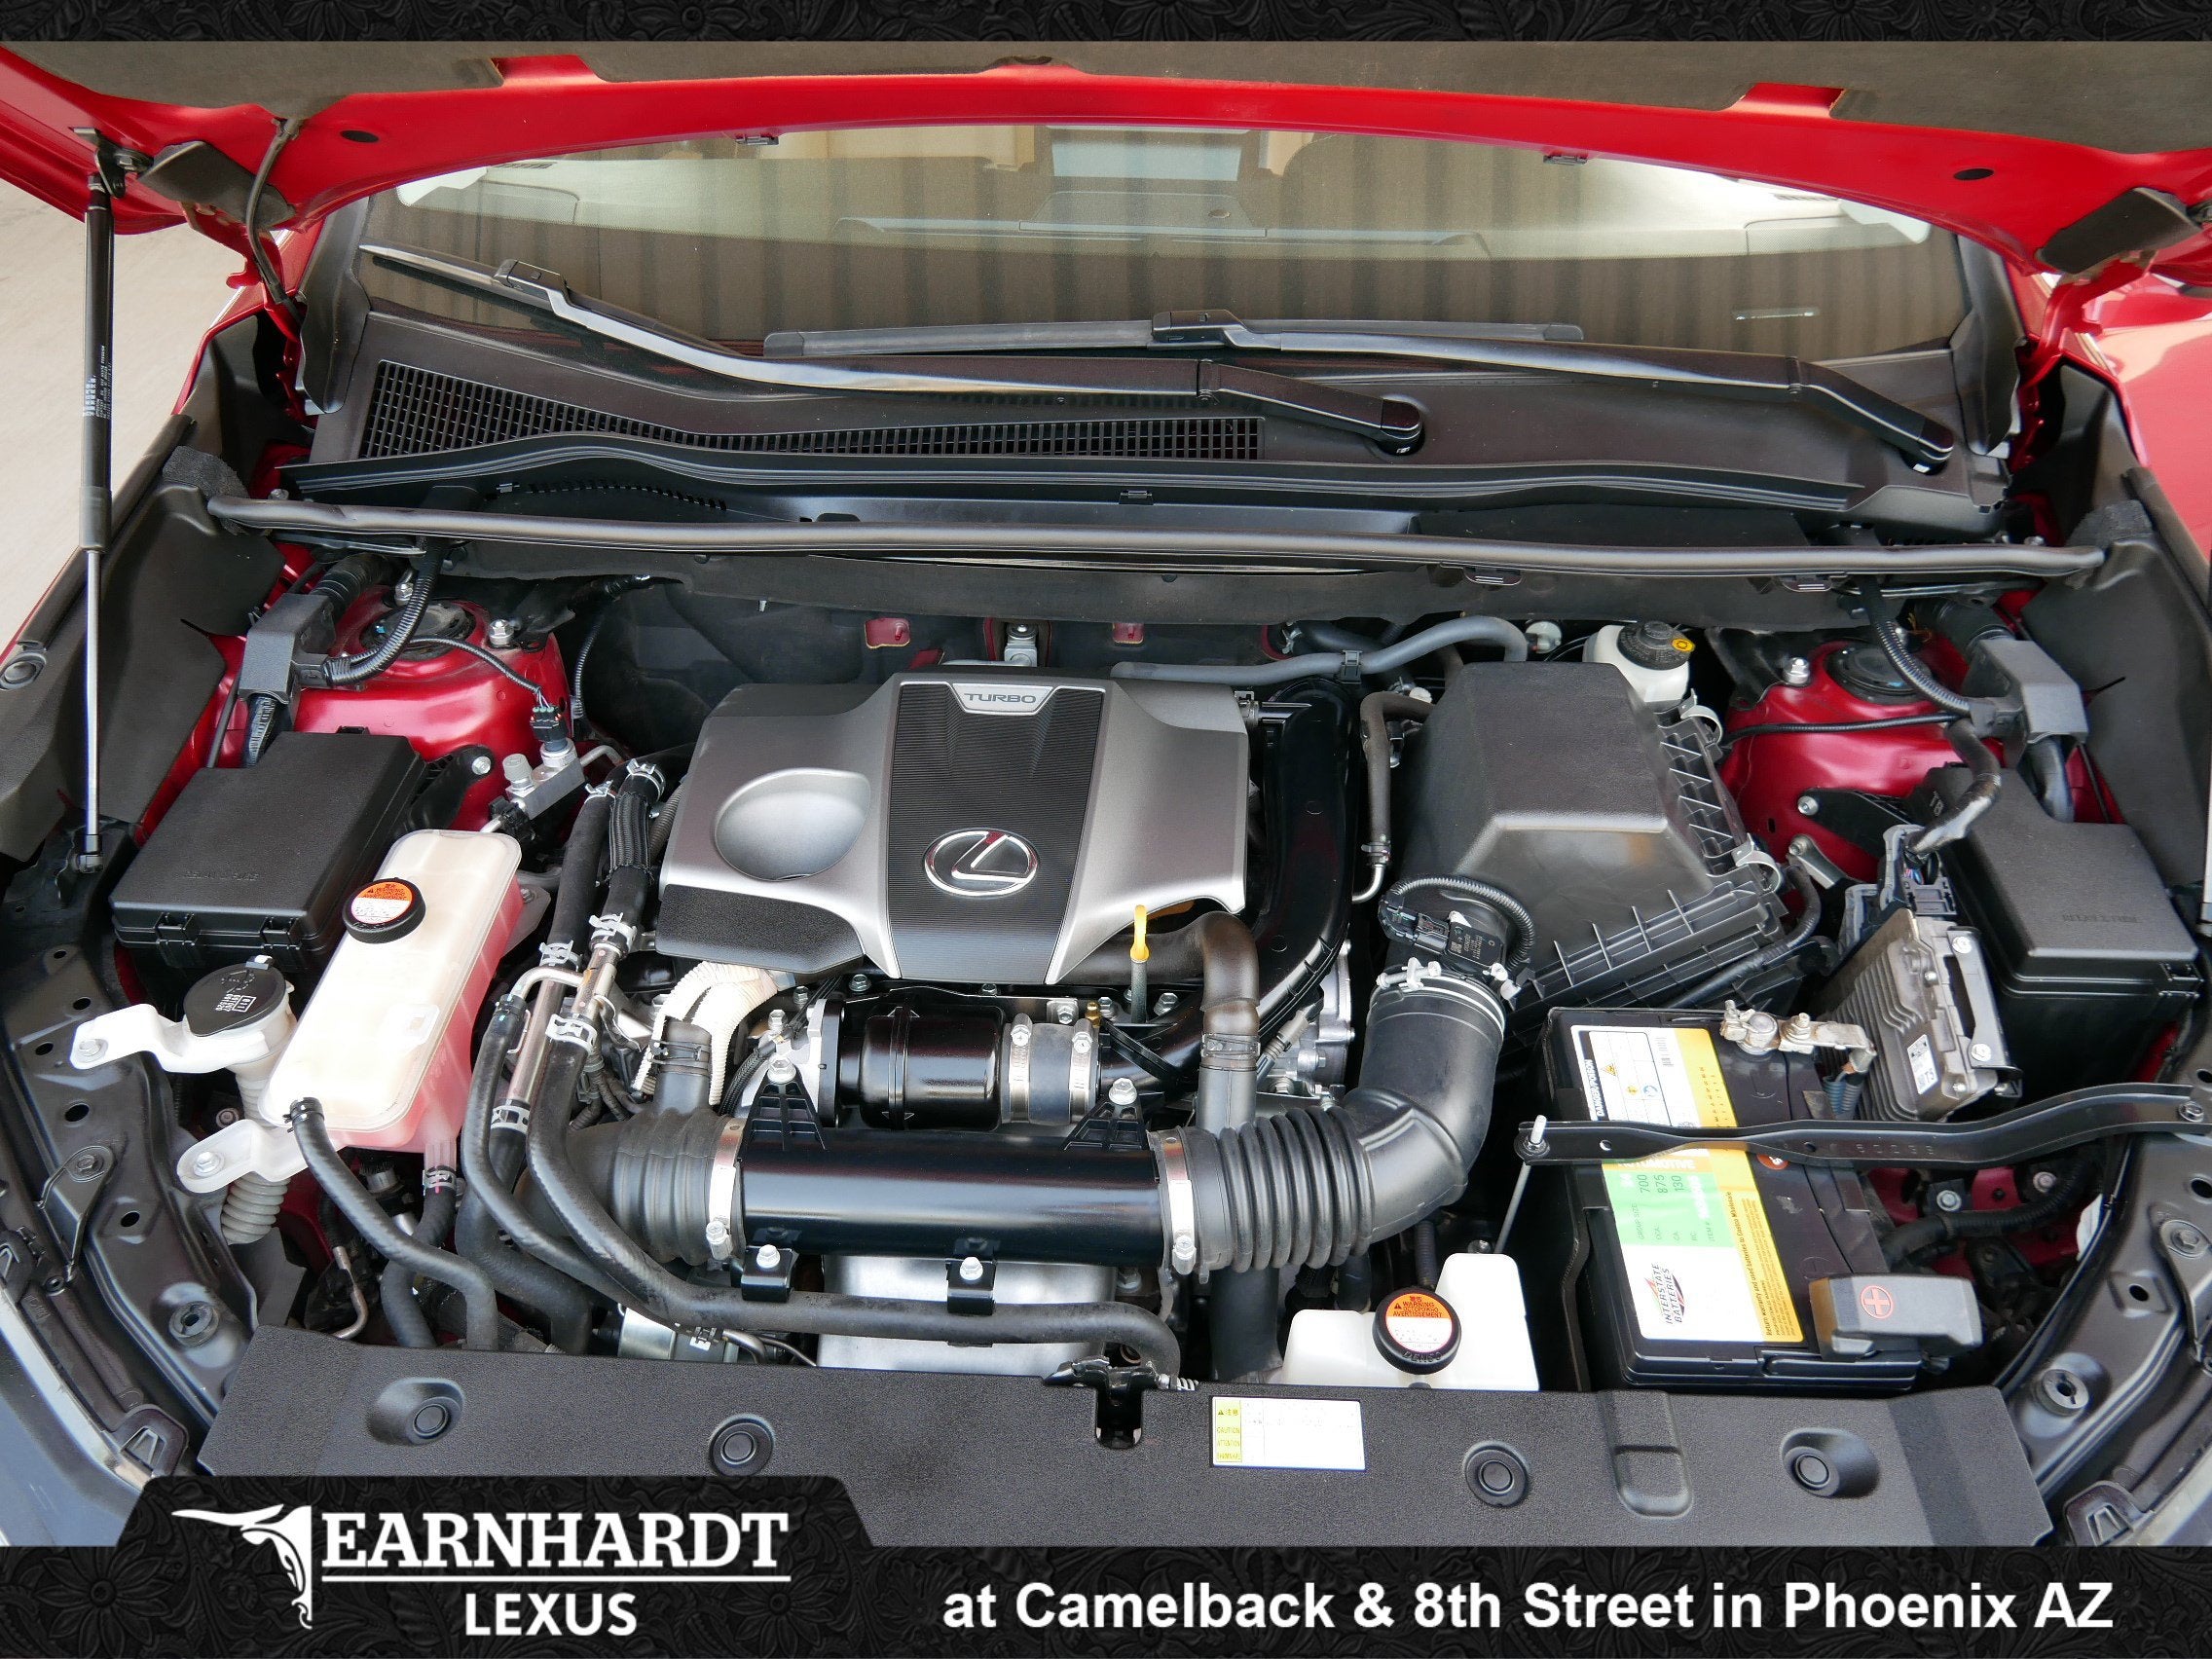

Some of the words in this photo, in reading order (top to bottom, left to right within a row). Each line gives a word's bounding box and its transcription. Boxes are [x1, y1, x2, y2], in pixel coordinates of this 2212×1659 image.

[964, 693, 1036, 704] TURBO
[1584, 1058, 1605, 1118] DANGER/POISON
[1637, 1174, 1650, 1194] 700
[1654, 1174, 1668, 1194] 875
[1672, 1175, 1685, 1193] 130
[1740, 1244, 1752, 1267] batteries
[1747, 1267, 1756, 1280] used
[1651, 1263, 1673, 1325] INTERSTATE
[1662, 1268, 1682, 1323] BATTERIES
[1751, 1279, 1760, 1292] and
[1754, 1293, 1768, 1316] warranty
[1761, 1317, 1772, 1336] Return
[1402, 1350, 1442, 1363] DENSO
